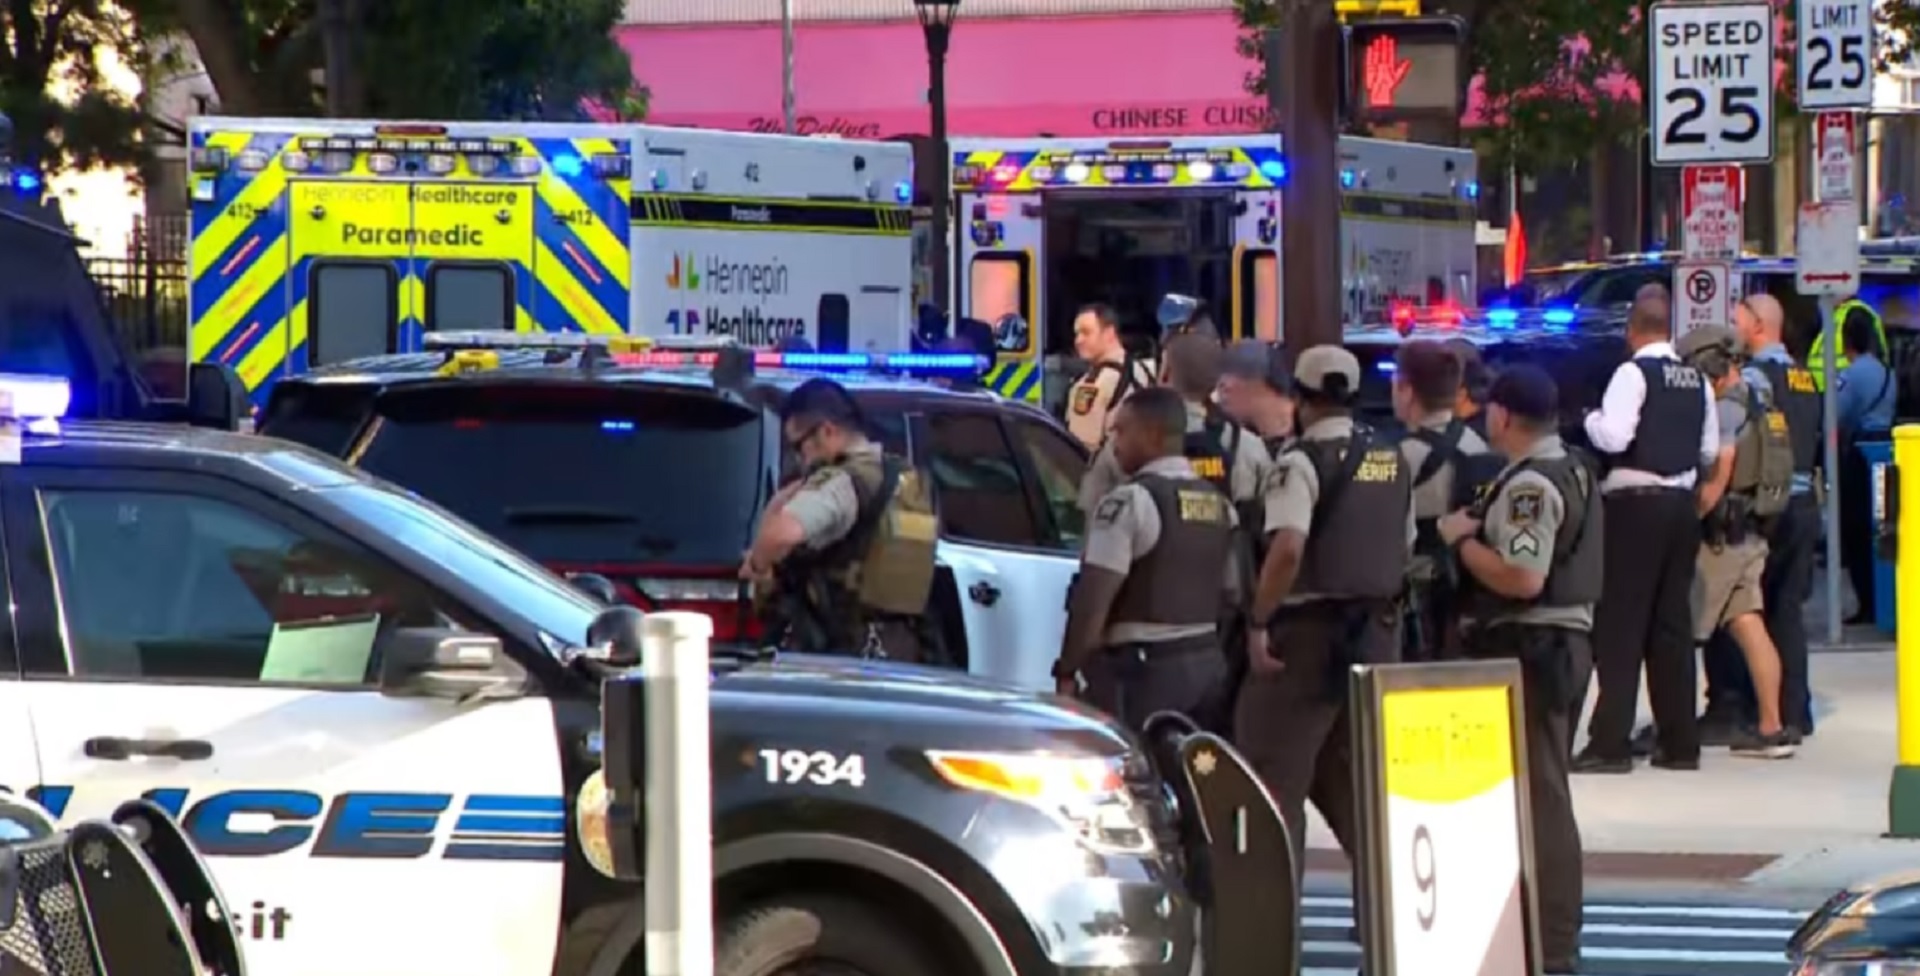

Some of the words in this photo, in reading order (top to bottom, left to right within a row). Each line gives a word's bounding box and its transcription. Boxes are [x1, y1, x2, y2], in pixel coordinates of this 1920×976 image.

[1811, 5, 1858, 29] LIMIT
[1662, 20, 1763, 46] SPEED
[1674, 54, 1750, 79] LIMIT
[1807, 35, 1866, 90] 25
[1092, 107, 1188, 129] CHINESE
[1665, 87, 1761, 144] 25
[408, 187, 518, 206] Healthcare
[342, 223, 483, 246] Paramedic
[705, 254, 788, 304] Hennepin
[705, 305, 805, 345] Healthcare
[1662, 365, 1700, 388] POLICE
[1353, 460, 1398, 482] HERIFF
[759, 749, 866, 787] 1934
[1411, 823, 1437, 933] 9
